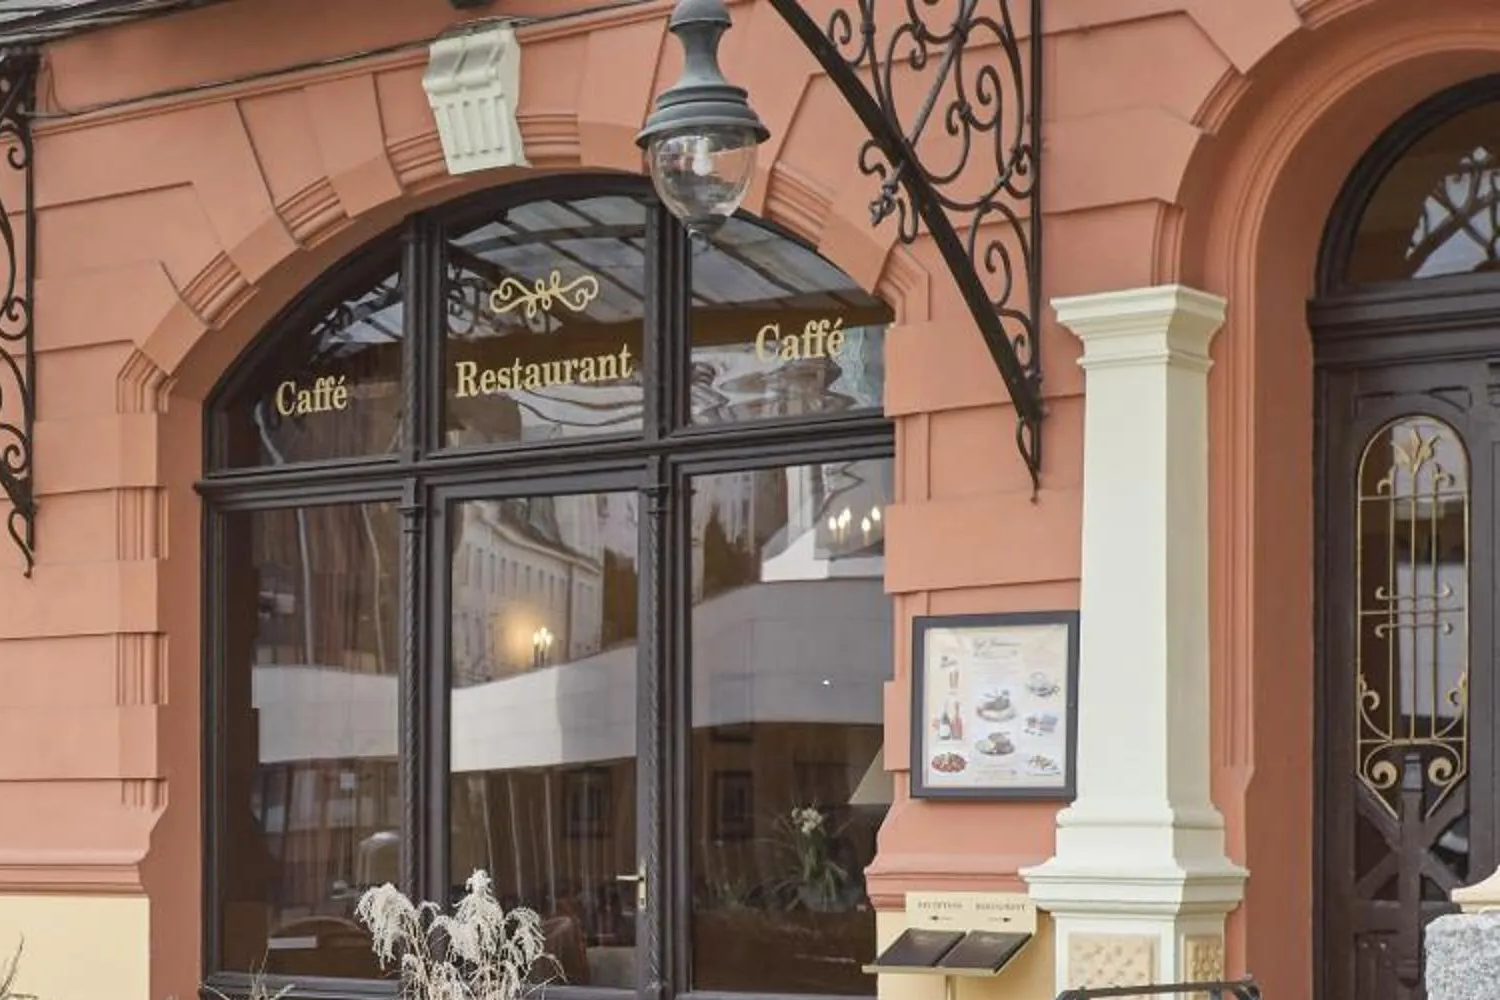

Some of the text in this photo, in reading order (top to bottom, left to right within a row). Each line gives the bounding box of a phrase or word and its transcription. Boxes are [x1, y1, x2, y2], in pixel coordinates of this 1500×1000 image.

[276, 318, 845, 416] Caffé Restaurant Caffé
